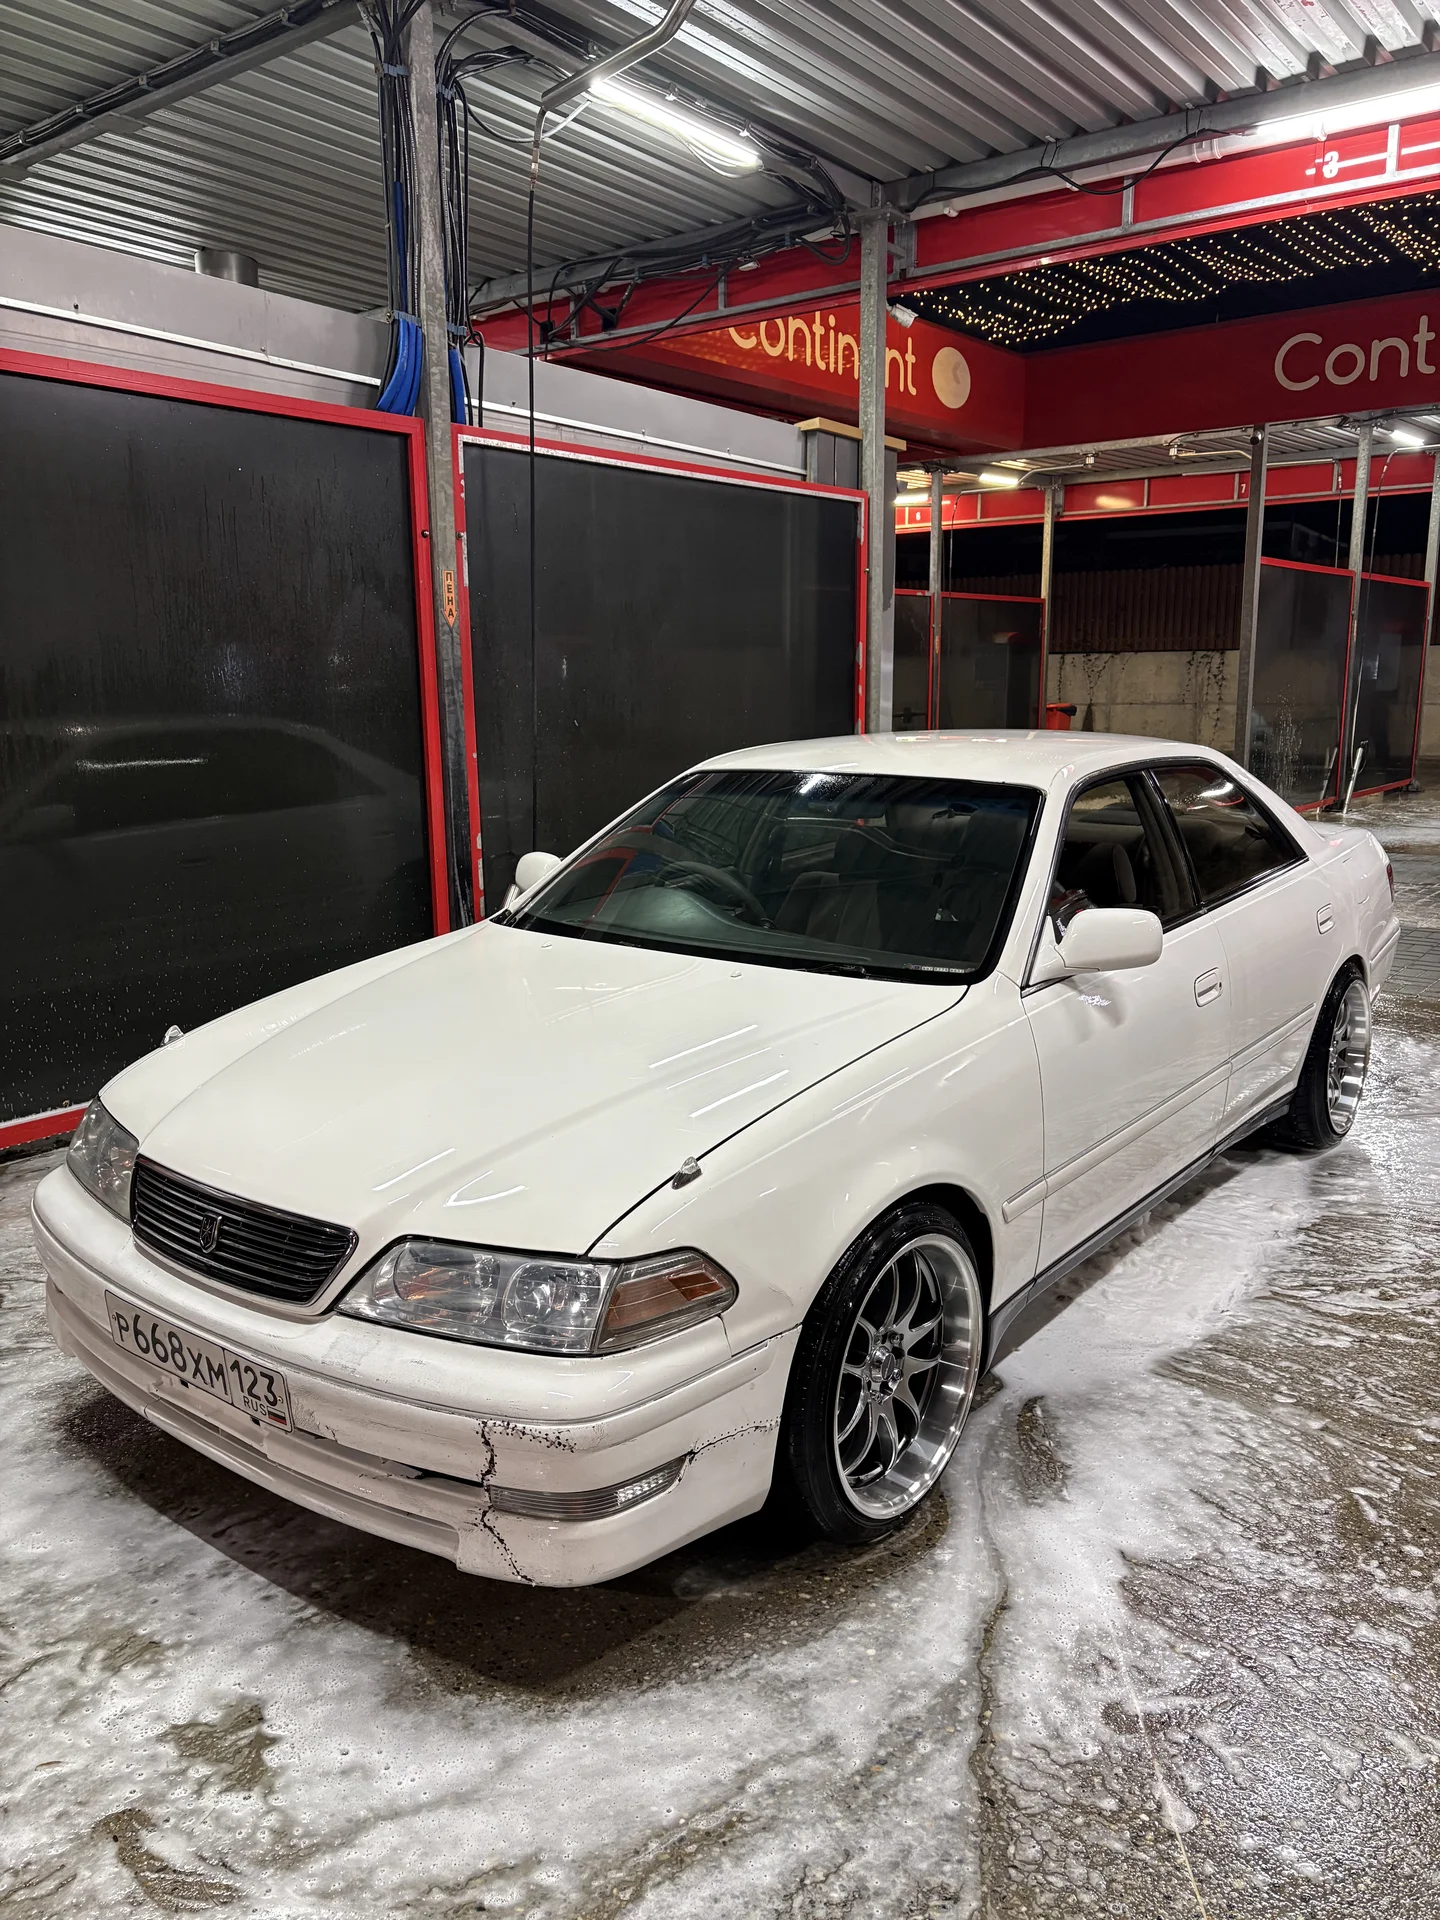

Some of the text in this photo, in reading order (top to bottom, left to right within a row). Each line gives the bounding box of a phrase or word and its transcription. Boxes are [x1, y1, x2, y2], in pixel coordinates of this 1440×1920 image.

[1322, 151, 1339, 178] 3
[1274, 315, 1436, 392] Cont
[1241, 483, 1246, 494] 7
[446, 571, 455, 618] ПЕНА
[230, 1359, 278, 1407] 123
[243, 1395, 267, 1416] RUS
